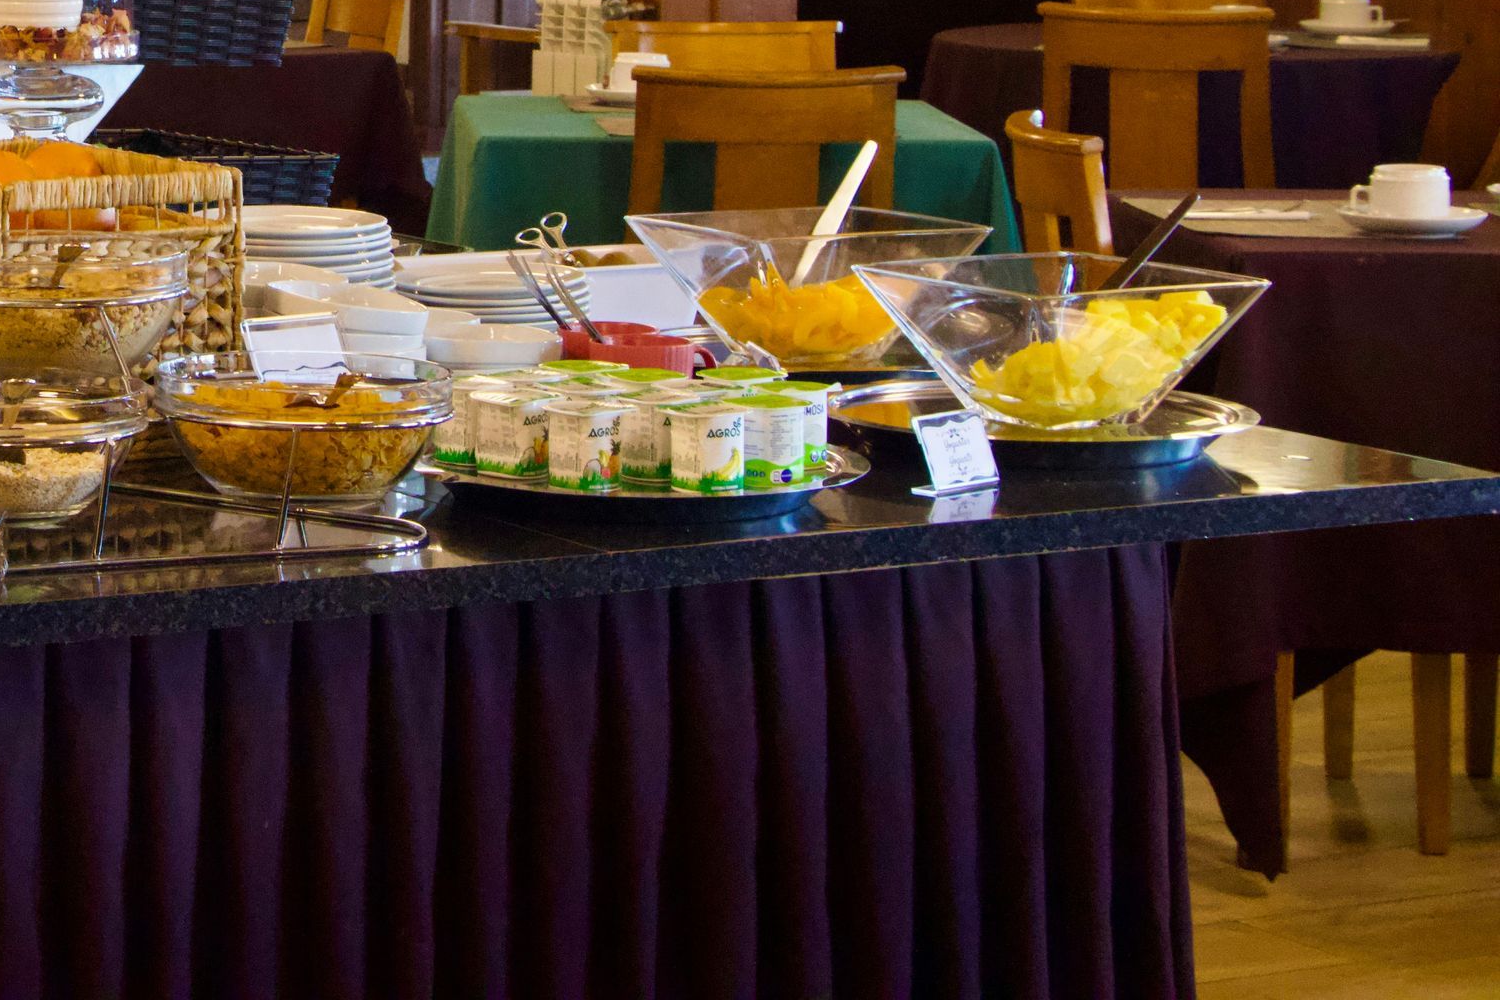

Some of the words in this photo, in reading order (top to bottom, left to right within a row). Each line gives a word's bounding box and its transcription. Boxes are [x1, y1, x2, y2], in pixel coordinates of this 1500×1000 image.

[803, 403, 825, 416] MOS
[523, 412, 549, 426] AGRO
[587, 425, 621, 438] AGROS
[706, 425, 742, 438] AGROS
